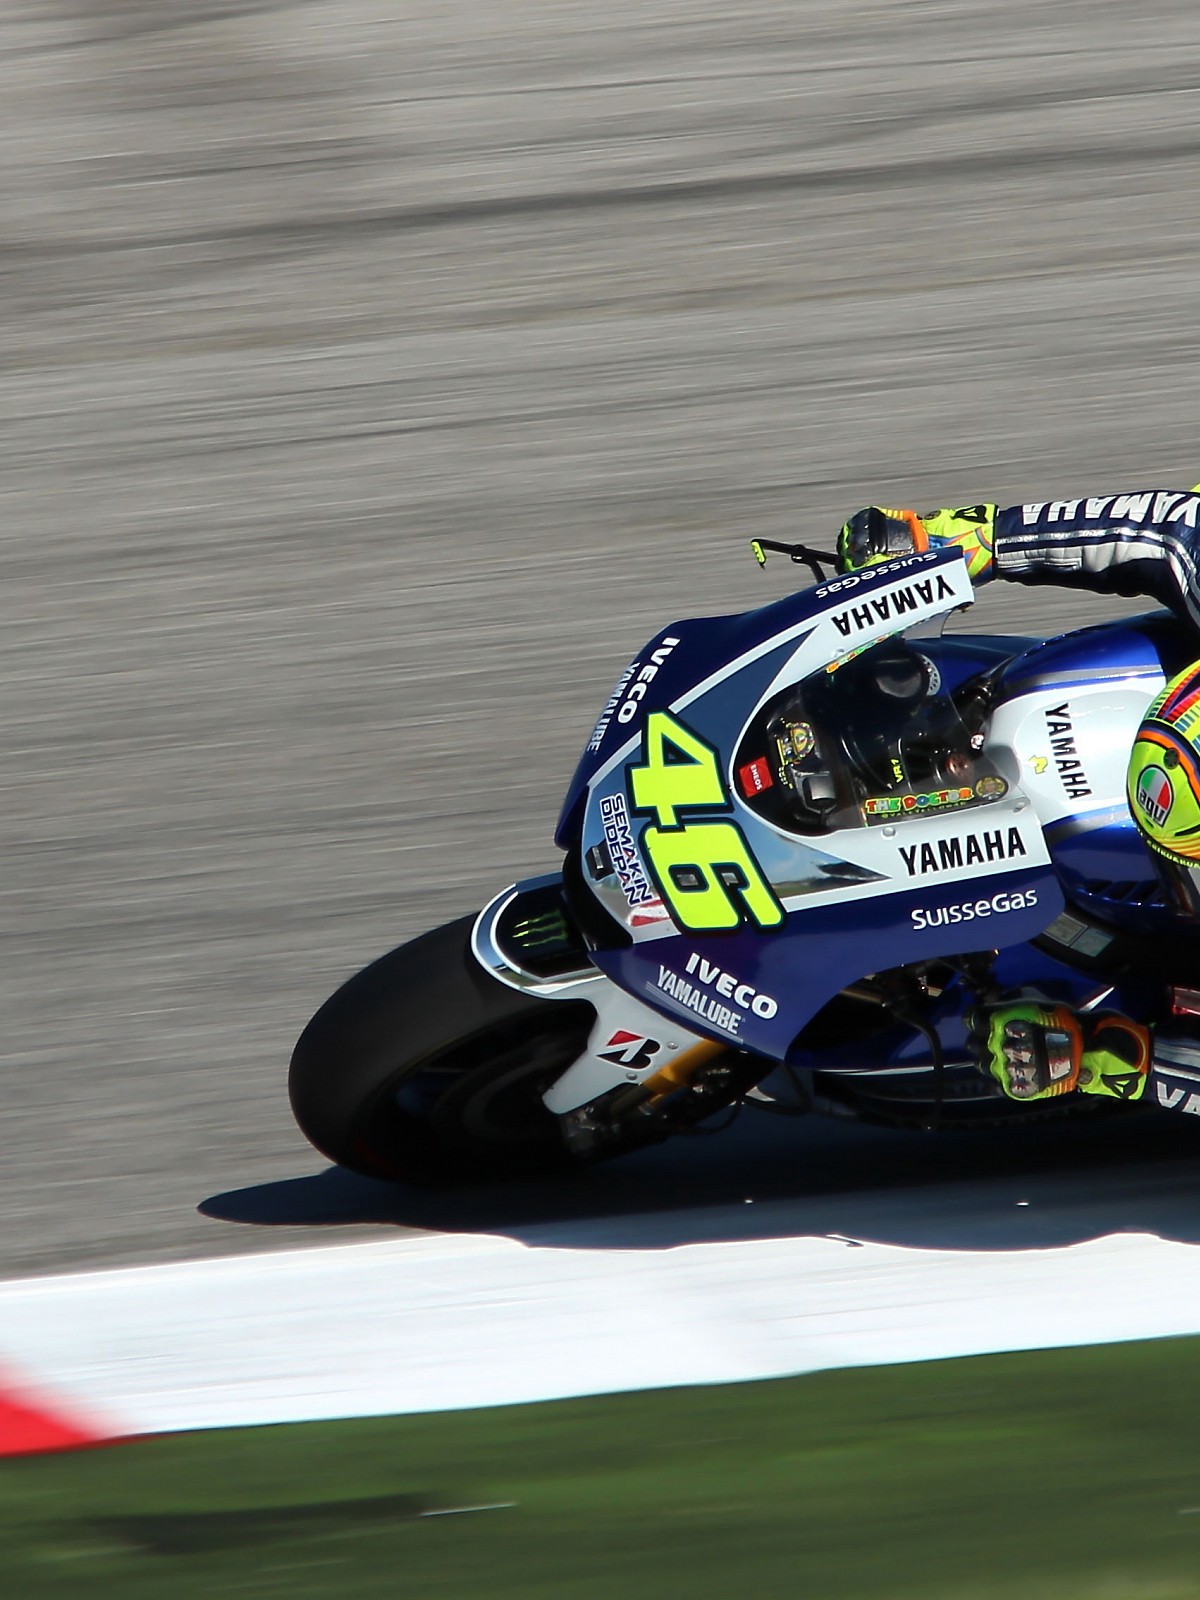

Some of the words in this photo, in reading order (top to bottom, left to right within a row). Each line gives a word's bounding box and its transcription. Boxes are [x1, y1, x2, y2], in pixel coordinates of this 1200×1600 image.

[831, 574, 956, 637] YAMAHA
[586, 662, 640, 752] YAMALUBE
[617, 637, 681, 724] IVECO
[750, 764, 763, 791] ENEOS
[1045, 702, 1092, 800] YAMAHA
[632, 711, 783, 929] 46
[865, 798, 901, 814] THE
[902, 787, 974, 811] DOCTOR
[1139, 788, 1165, 822] agv
[898, 826, 1027, 876] YAMAHA
[656, 964, 742, 1035] YAMALUBE
[685, 952, 779, 1020] IVECO
